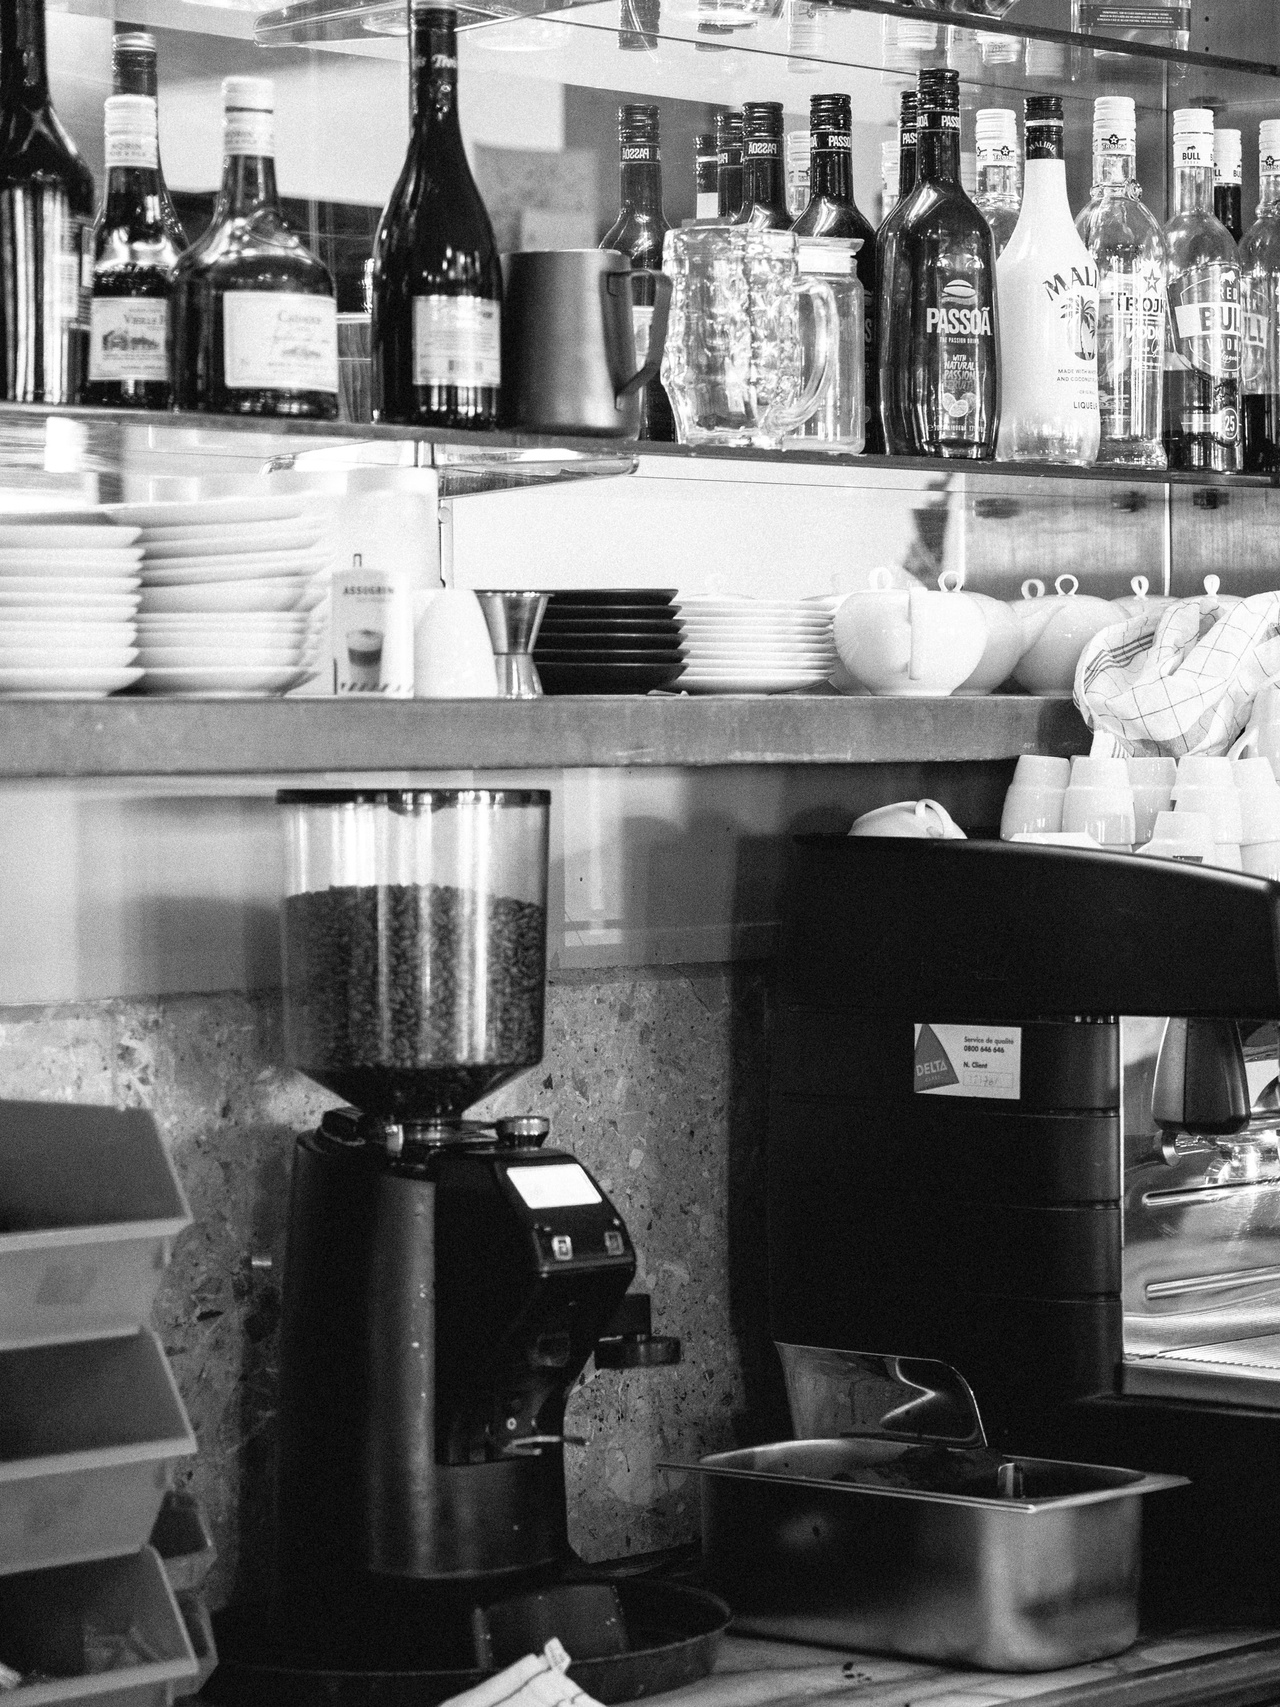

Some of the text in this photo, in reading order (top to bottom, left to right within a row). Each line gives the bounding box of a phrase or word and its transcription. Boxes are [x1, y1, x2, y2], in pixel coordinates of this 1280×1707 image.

[828, 135, 851, 147] PASSO
[1182, 152, 1201, 161] BULL
[1042, 265, 1098, 302] MALI
[1219, 287, 1238, 299] RED
[926, 306, 991, 336] PASSOÃ
[952, 354, 967, 362] WITH
[944, 360, 975, 370] NATURAL
[1224, 415, 1235, 432] 25
[964, 1035, 1014, 1046] Service de qualité
[993, 1046, 1005, 1054] 646
[915, 1059, 948, 1077] DELTA
